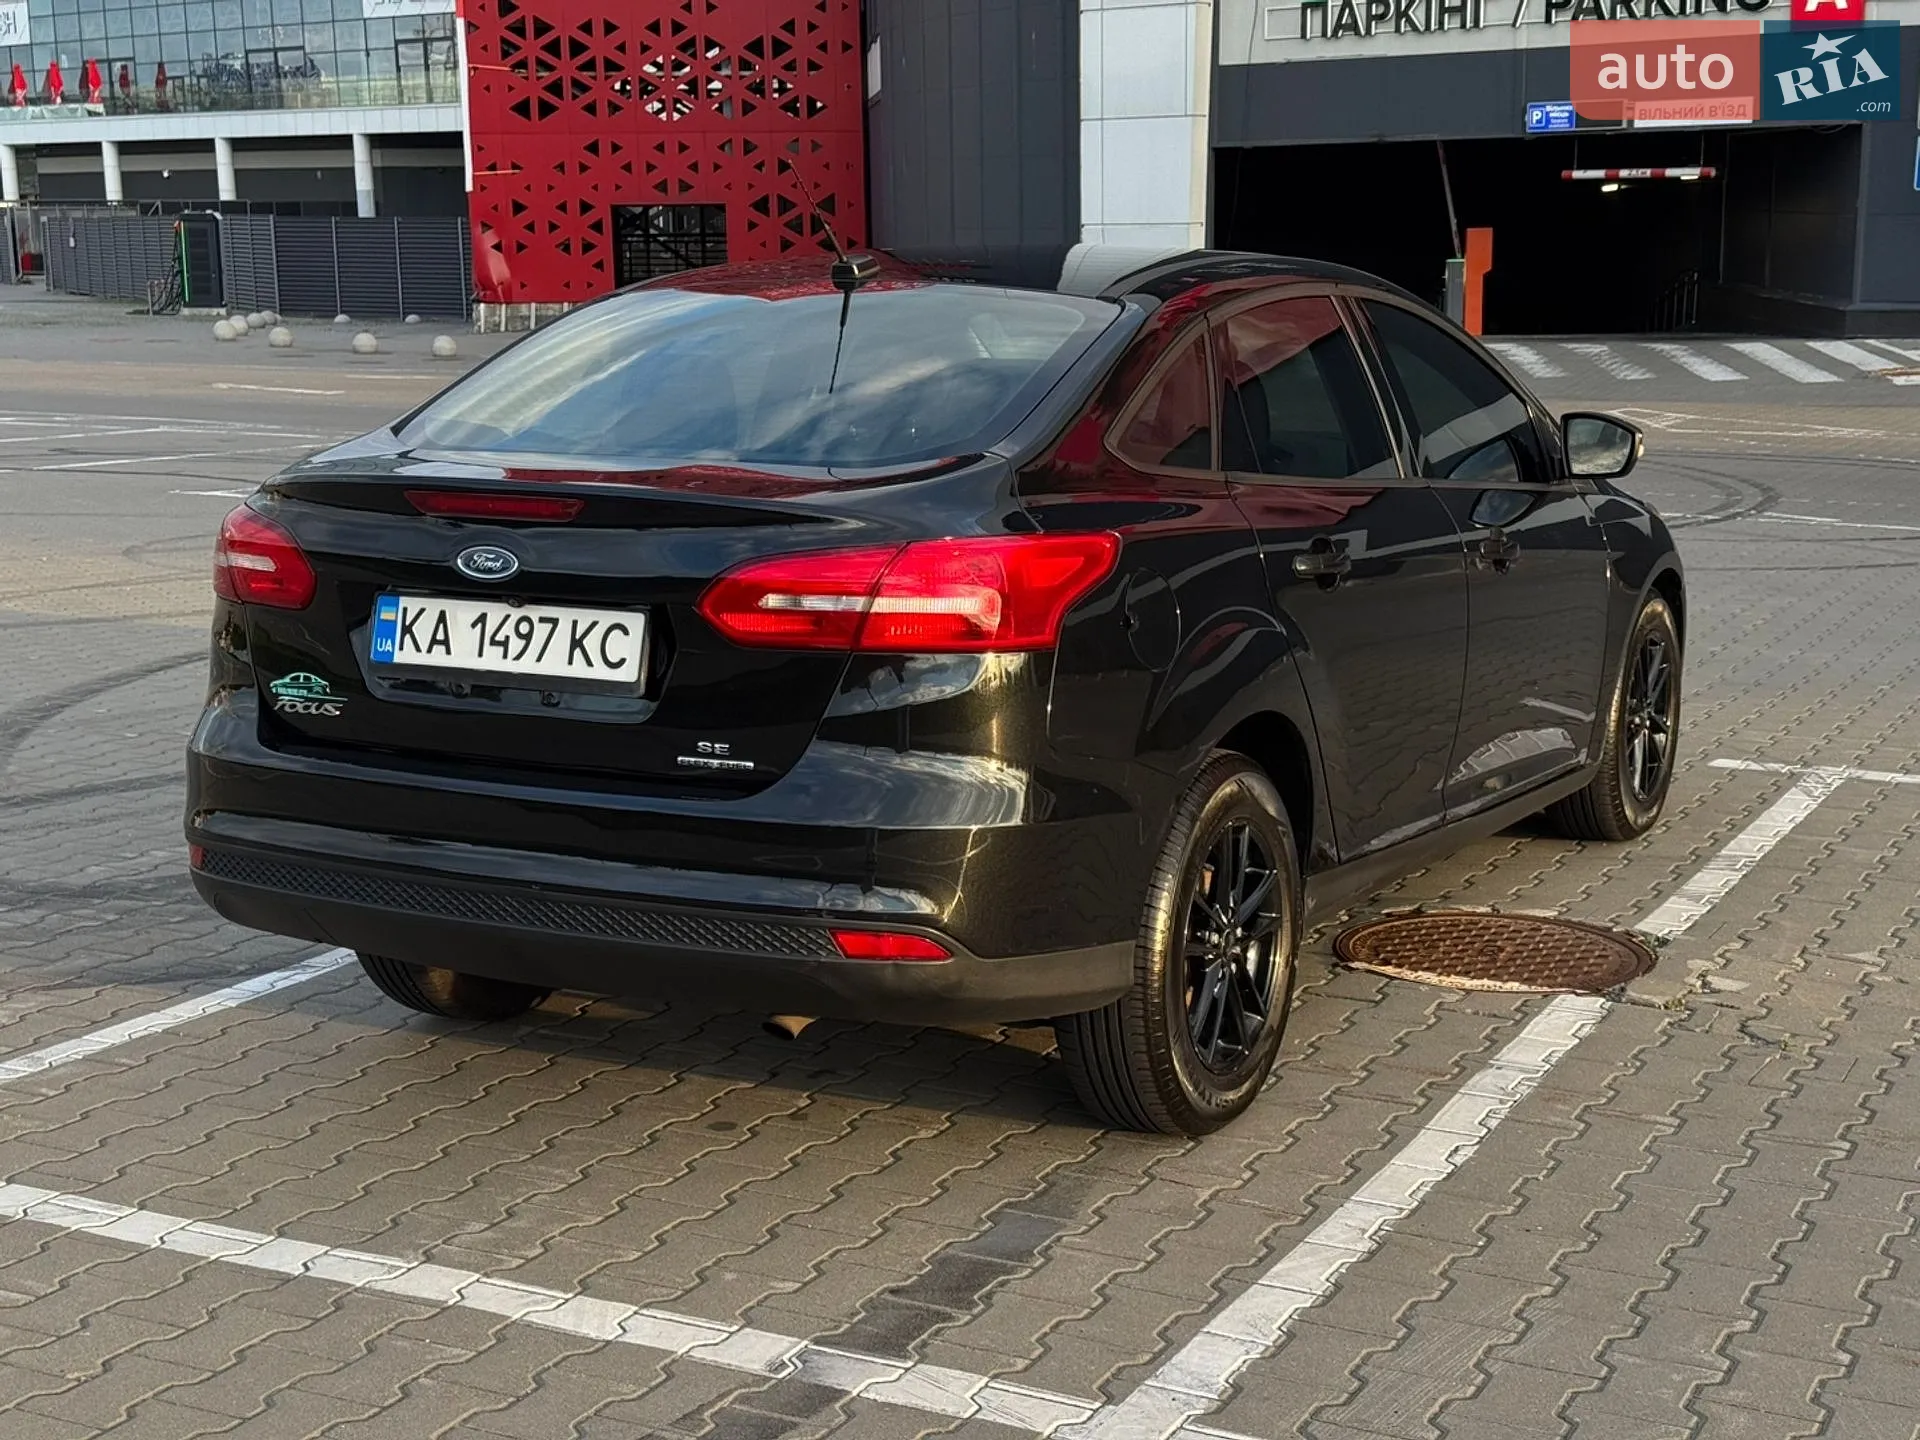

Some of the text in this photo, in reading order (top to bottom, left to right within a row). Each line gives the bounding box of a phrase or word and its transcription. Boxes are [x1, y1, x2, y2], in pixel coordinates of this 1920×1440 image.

[1639, 105, 1704, 120] ВІЛЬНИЙ
[469, 552, 504, 571] Ford
[377, 637, 392, 653] UA
[399, 606, 631, 670] KA 1497 KC
[696, 741, 730, 756] SE
